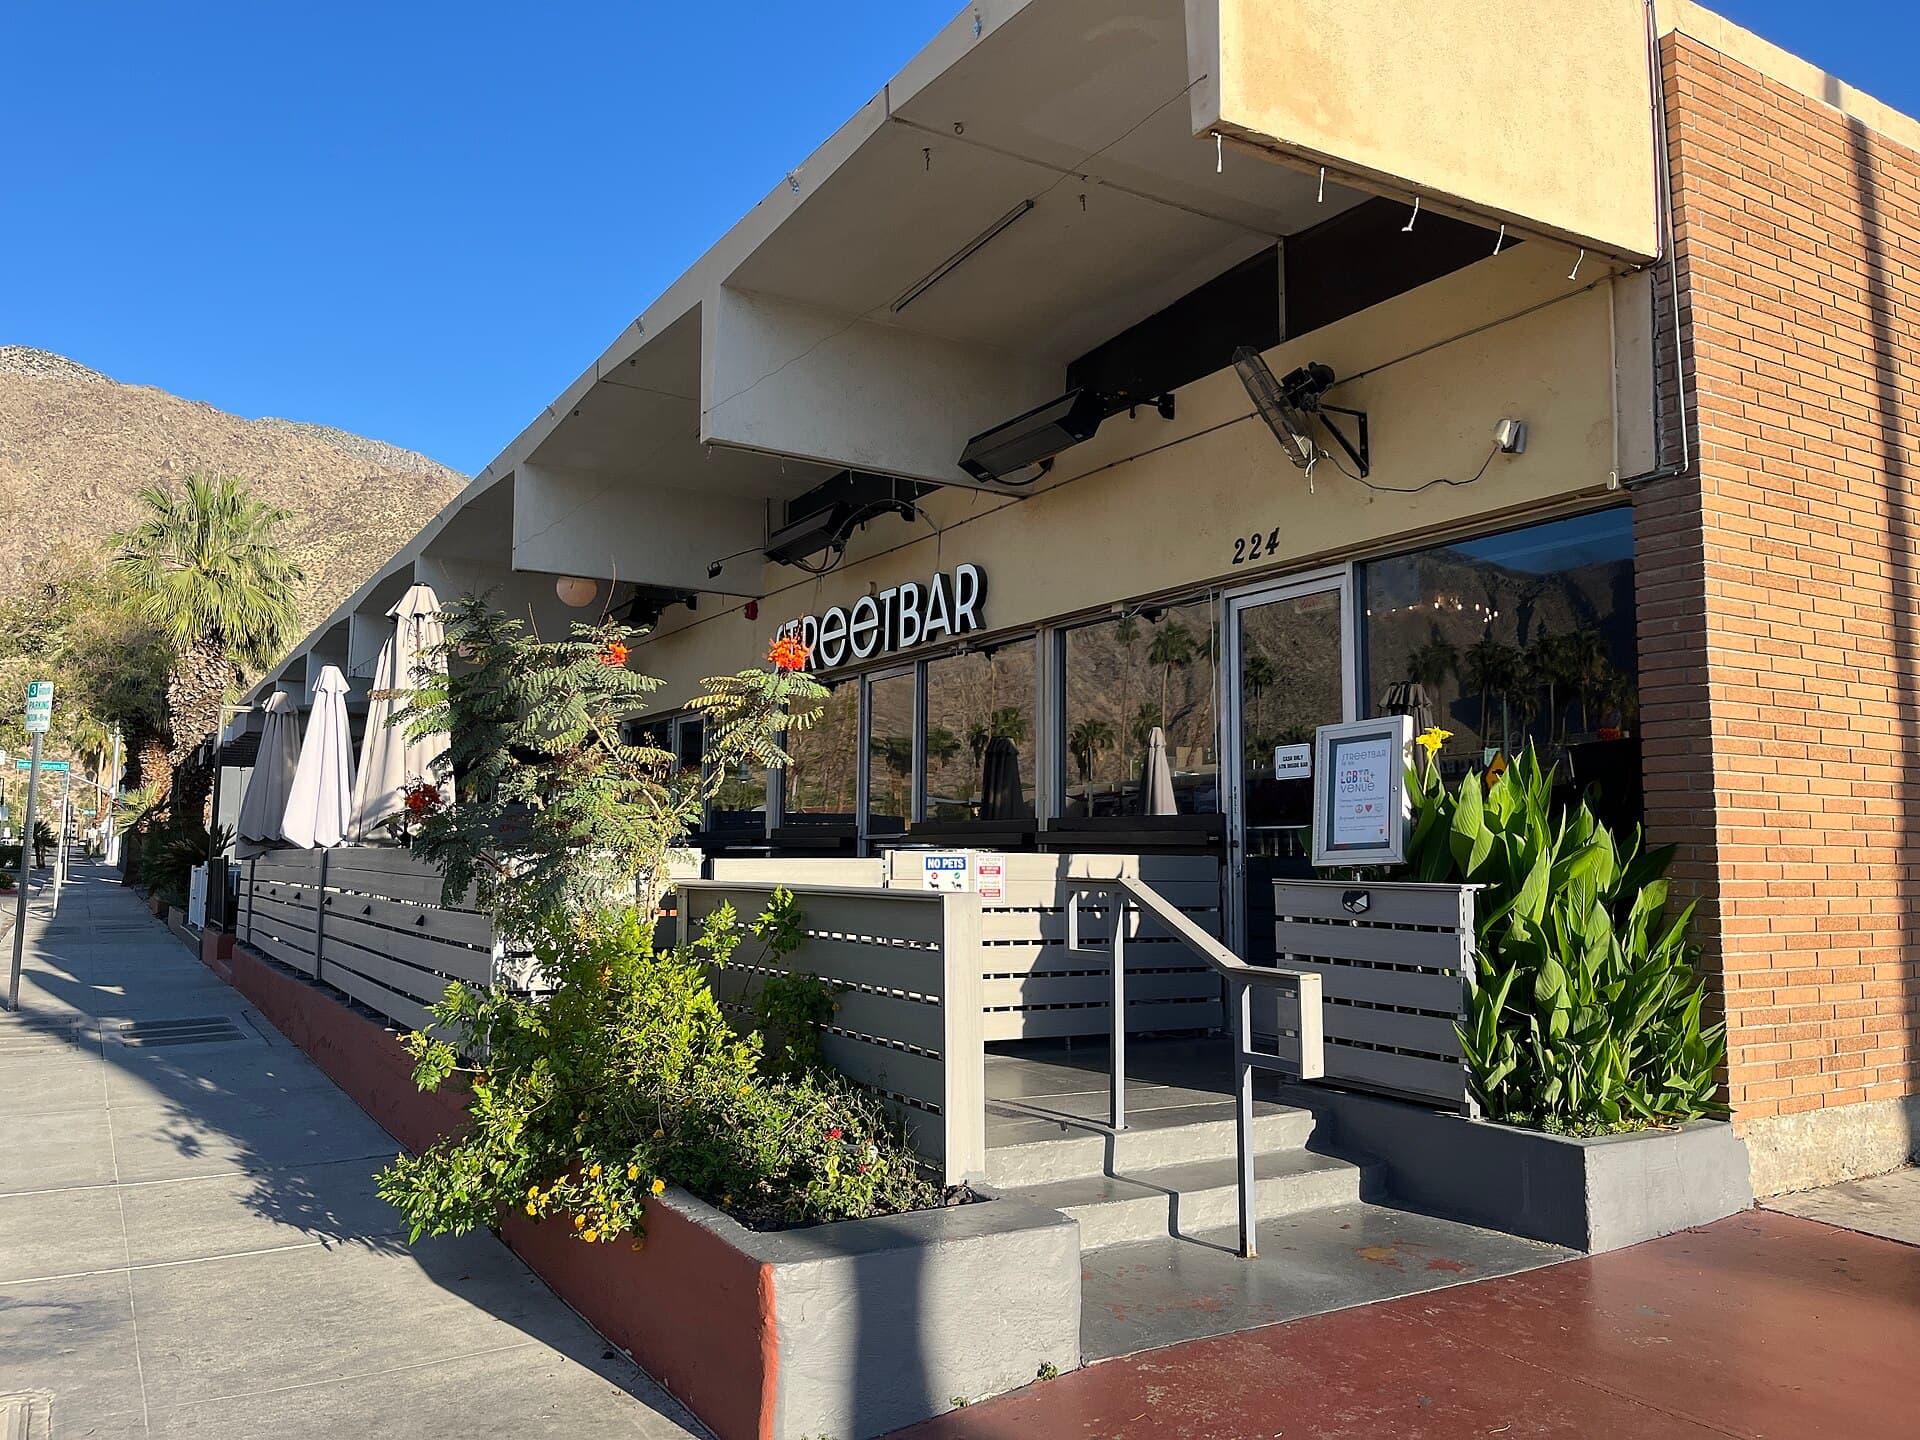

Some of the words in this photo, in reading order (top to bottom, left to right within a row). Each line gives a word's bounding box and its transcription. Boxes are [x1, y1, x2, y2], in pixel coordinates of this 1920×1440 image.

[1232, 527, 1280, 564] 224
[31, 685, 37, 696] 3
[29, 701, 50, 711] PARKING
[1340, 768, 1375, 784] LGBTQ+
[927, 858, 941, 869] NO
[942, 858, 965, 869] PETS
